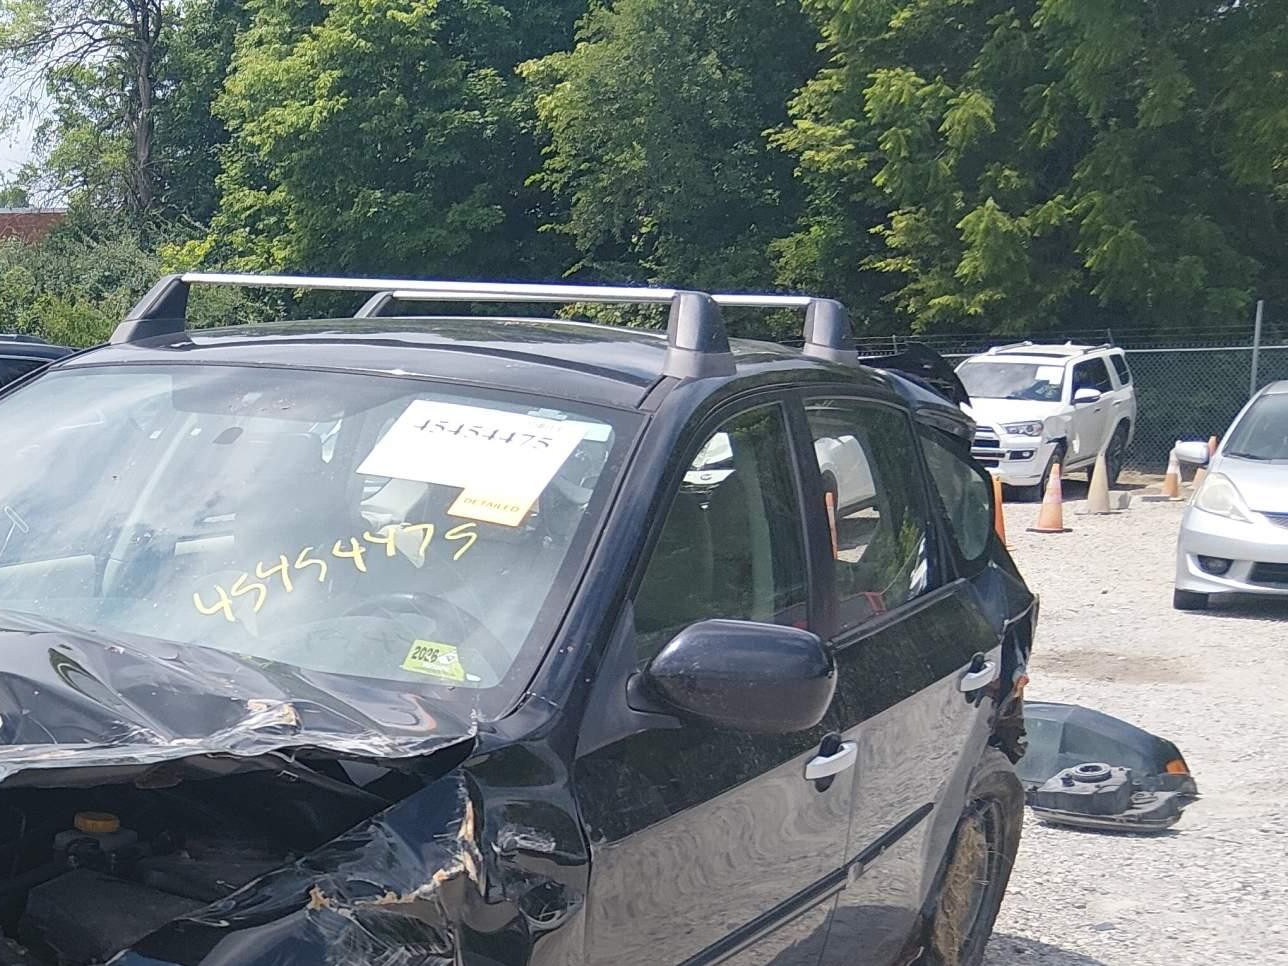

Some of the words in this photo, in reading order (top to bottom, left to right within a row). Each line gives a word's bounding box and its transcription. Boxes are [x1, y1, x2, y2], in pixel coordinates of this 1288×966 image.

[414, 419, 553, 448] 45454475
[464, 497, 520, 512] DETAILED
[193, 522, 478, 622] 45454475
